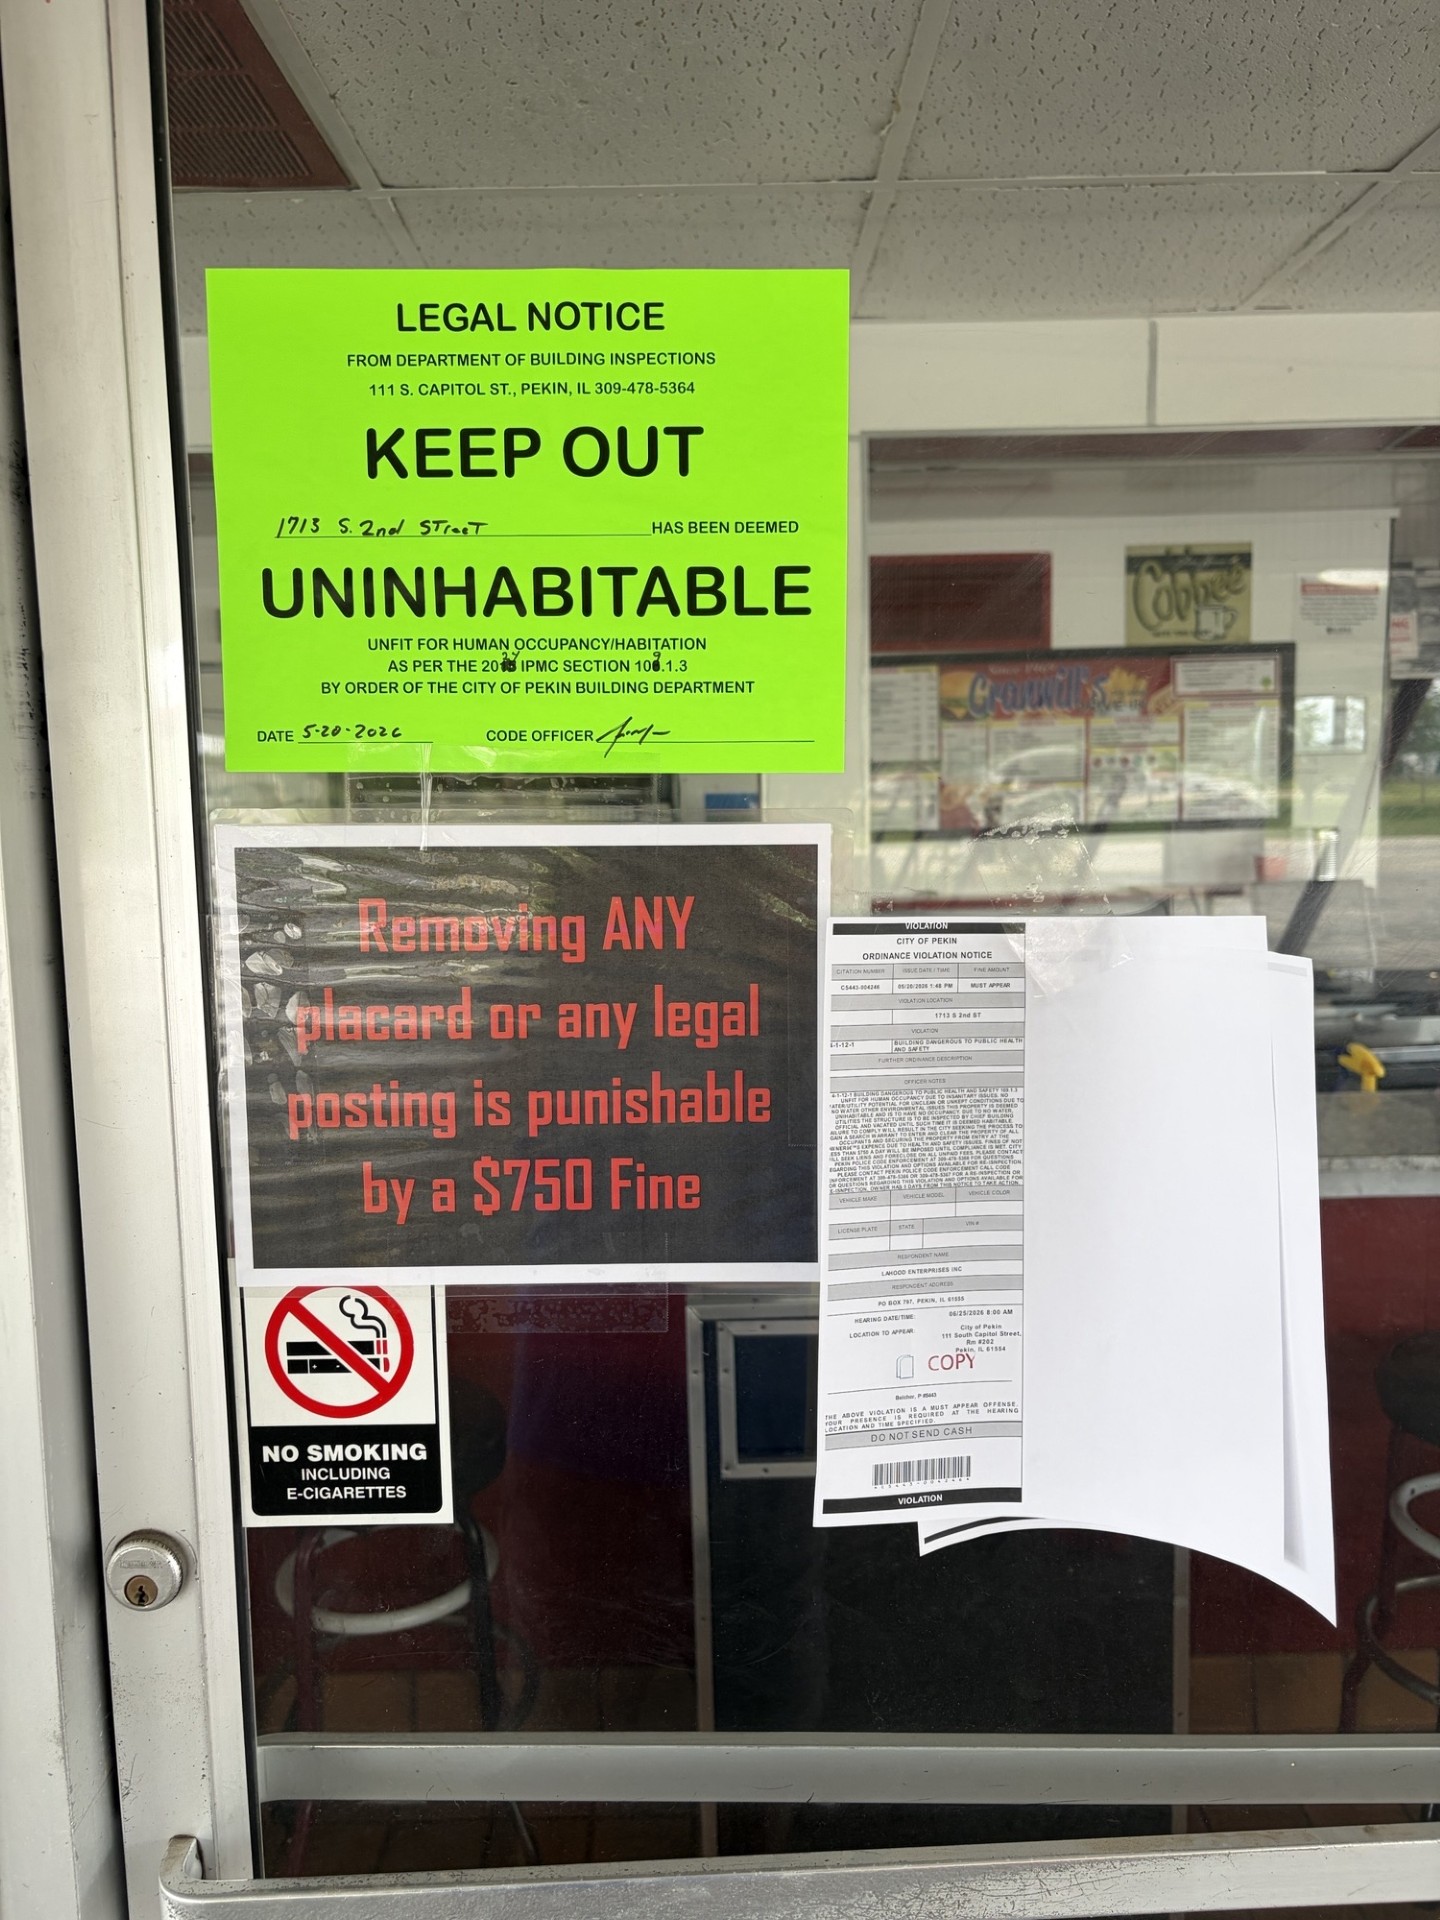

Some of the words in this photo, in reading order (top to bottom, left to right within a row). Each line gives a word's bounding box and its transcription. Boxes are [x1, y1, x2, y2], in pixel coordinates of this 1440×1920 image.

[398, 303, 516, 332] LEGAL
[528, 302, 664, 331] NOTICE
[348, 354, 391, 366] FROM
[397, 354, 500, 366] DEPARTMENT
[505, 354, 525, 366] OF
[531, 353, 604, 365] BUILDING
[611, 352, 715, 365] INSPECTIONS
[370, 384, 393, 396] 111
[400, 384, 413, 396] S.
[419, 384, 485, 395] CAPITOL
[490, 383, 516, 397] ST.,
[522, 382, 572, 395] PEKIN,
[578, 382, 590, 394] IL
[596, 382, 694, 394] 309-478-5364
[367, 428, 540, 479] KEEP
[563, 426, 704, 477] OUT
[360, 519, 405, 537] 2nd
[652, 522, 683, 534] HAS
[689, 522, 729, 533] BEEN
[735, 521, 798, 533] DEEMED
[261, 565, 813, 618] UNINHABITABLE
[368, 638, 413, 650] UNFIT
[418, 638, 448, 650] FOR
[454, 638, 509, 650] HUMAN
[514, 638, 706, 650] OCCUPANCY/HABITATION
[388, 660, 410, 672] AS
[413, 660, 443, 672] PER
[447, 660, 477, 672] THE
[521, 660, 559, 672] IPMC
[562, 660, 630, 672] SECTION
[322, 682, 340, 694] BY
[345, 682, 397, 694] ORDER
[403, 682, 423, 693] OF
[428, 682, 457, 693] THE
[462, 682, 496, 693] CITY
[501, 682, 520, 694] OF
[526, 682, 570, 693] PEKIN
[576, 682, 648, 693] BUILDING
[654, 682, 754, 693] DEPARTMENT
[258, 731, 294, 742] DATE
[486, 730, 527, 741] CODE
[532, 730, 593, 741] OFFICER
[359, 898, 587, 963] Removing
[603, 896, 695, 950] ANY
[863, 952, 910, 960] ORDINANCE
[297, 986, 471, 1053] placard
[491, 1002, 541, 1039] or
[558, 1002, 637, 1049] any
[655, 983, 759, 1047] legal
[288, 1080, 456, 1139] posting
[474, 1079, 511, 1126] is
[528, 1070, 771, 1137] punishable
[363, 1161, 415, 1223] by
[432, 1179, 455, 1213] a
[474, 1156, 592, 1216] $750
[611, 1157, 701, 1210] Fine
[908, 1267, 949, 1275] ENTERPRISES
[855, 1316, 882, 1324] HEARING
[884, 1314, 916, 1322] DATE/TIME:
[928, 1353, 975, 1371] COPY
[869, 1408, 906, 1416] VIOLATION
[909, 1411, 944, 1419] REQUIRED
[825, 1425, 858, 1433] LOCATION
[871, 1434, 886, 1442] DO
[889, 1432, 909, 1441] NOT
[912, 1429, 939, 1439] SEND
[943, 1427, 973, 1436] CASH
[262, 1444, 299, 1462] NO
[307, 1443, 428, 1462] SMOKING
[301, 1468, 391, 1481] INCLUDING
[287, 1486, 407, 1501] E-CIGARETTES
[898, 1494, 942, 1505] VIOLATION
